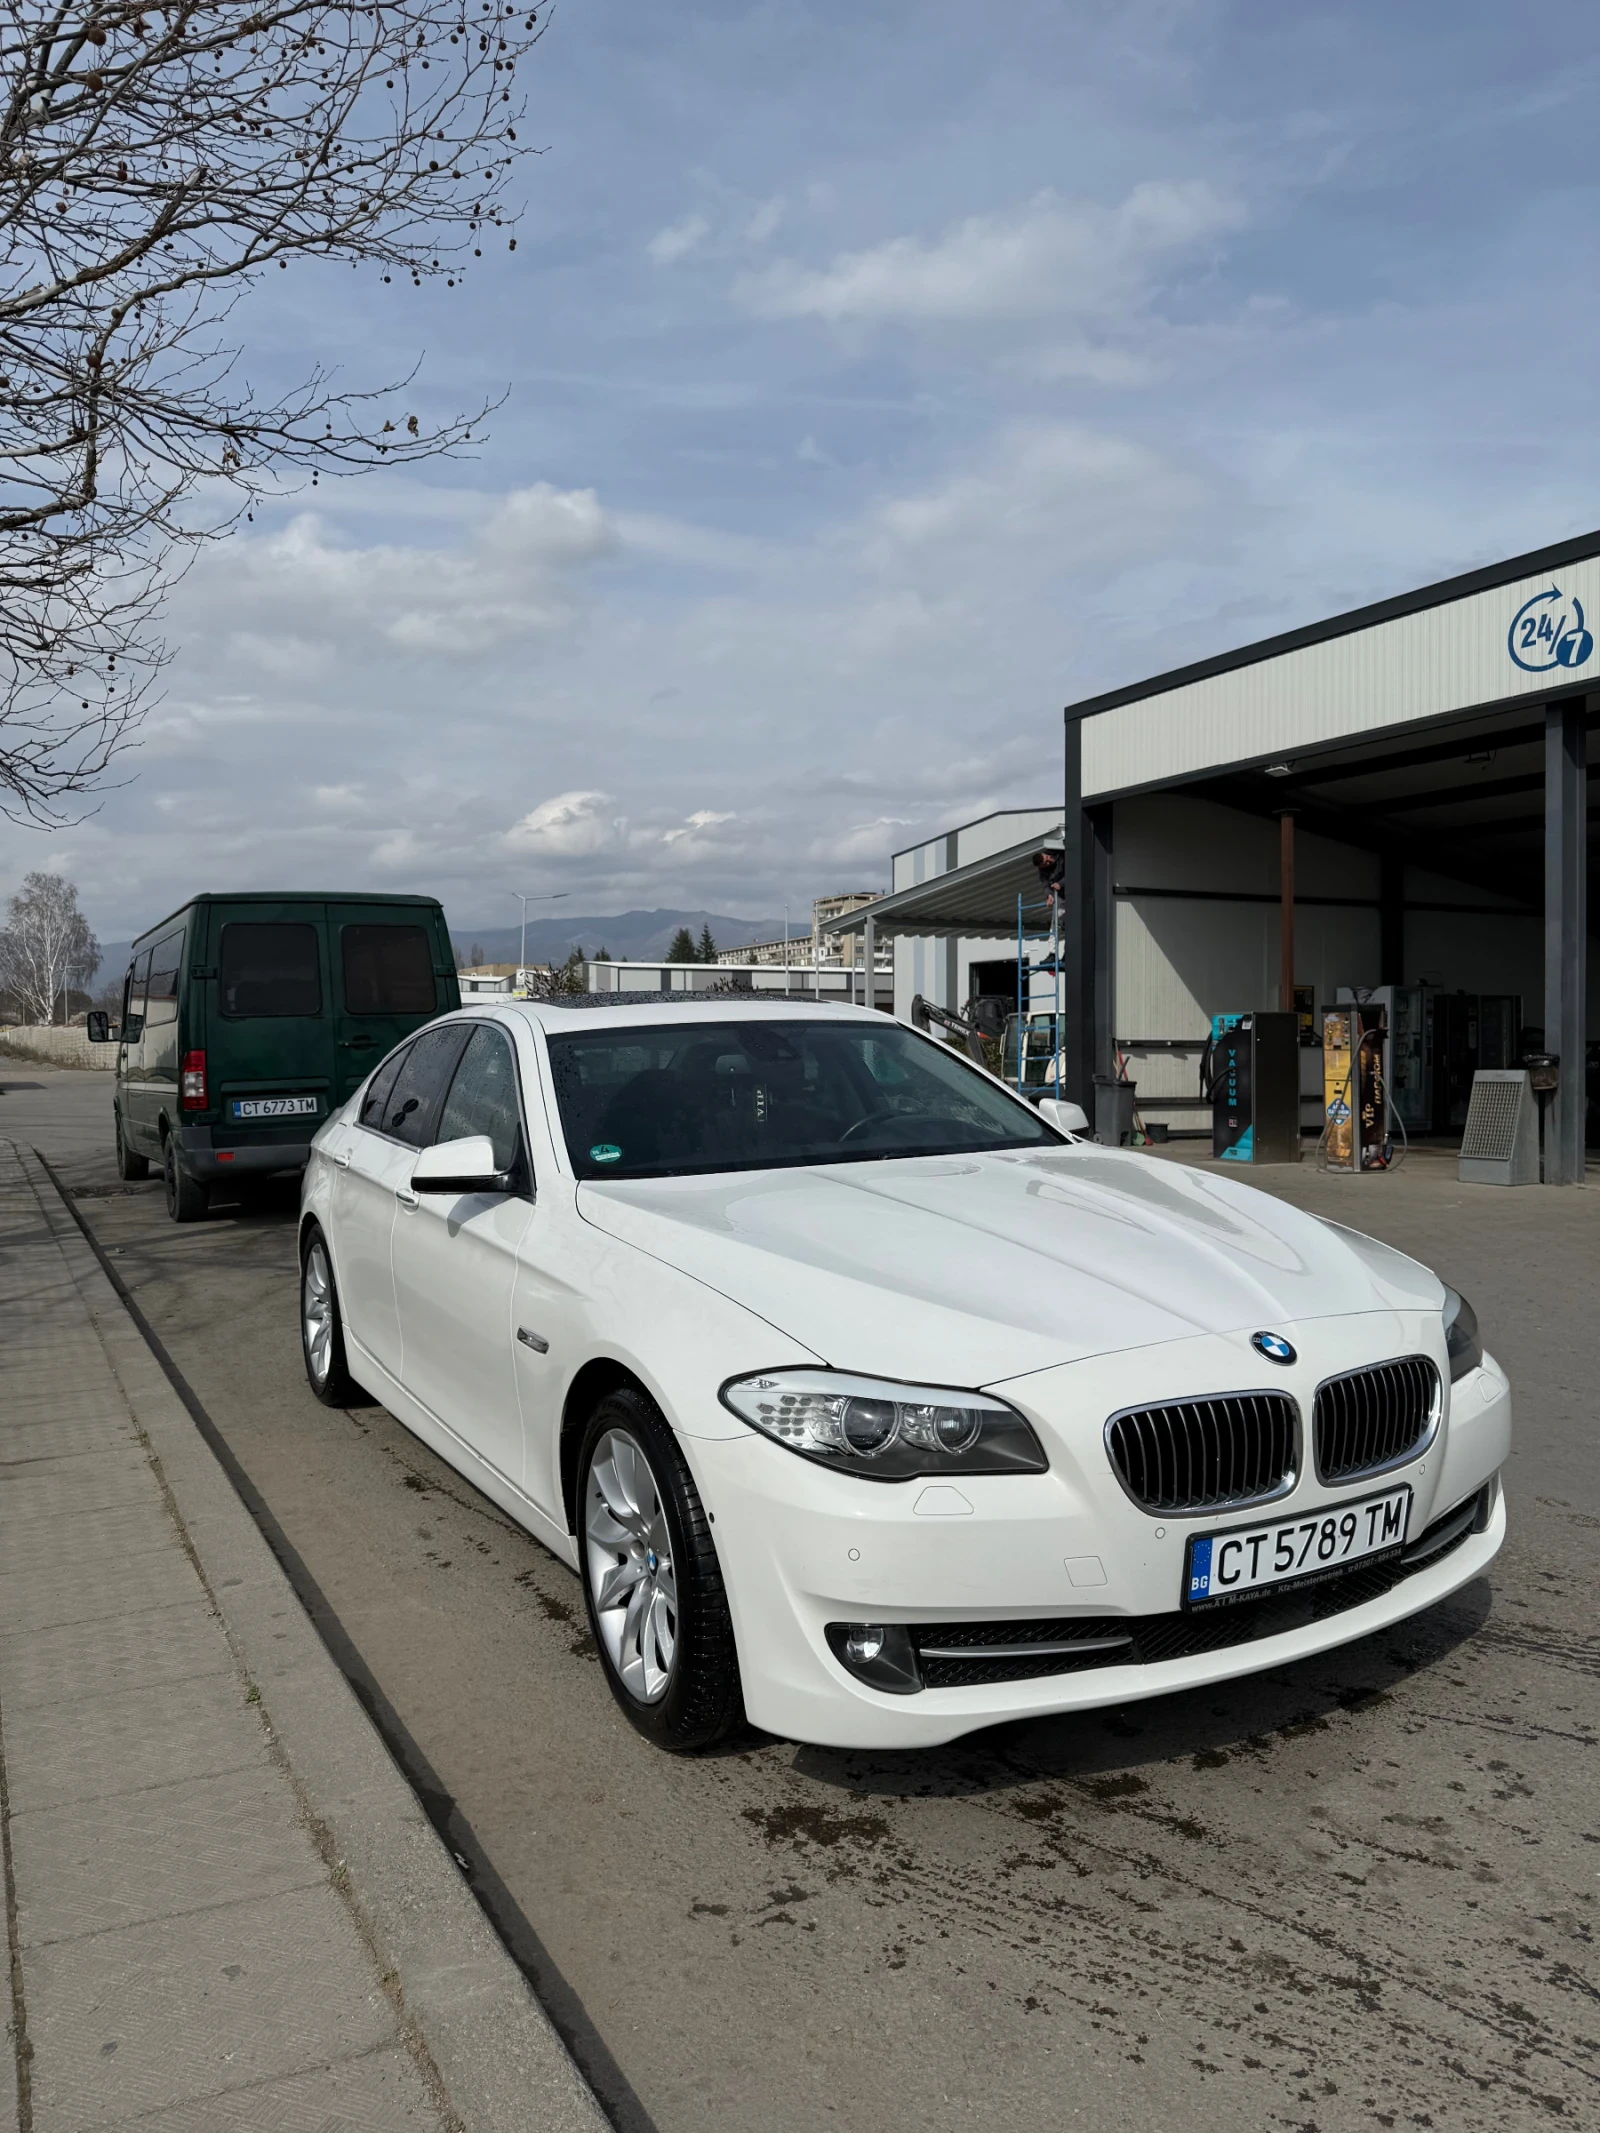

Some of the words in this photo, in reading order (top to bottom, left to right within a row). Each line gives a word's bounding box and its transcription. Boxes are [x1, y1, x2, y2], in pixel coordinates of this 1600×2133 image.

[1521, 613, 1583, 665] 24/7
[950, 1021, 971, 1036] TEREX
[243, 1102, 260, 1115] CT
[263, 1100, 295, 1114] 6773
[297, 1099, 315, 1112] TM
[1365, 1103, 1375, 1129] VIP
[1218, 1533, 1268, 1586] CT
[1274, 1513, 1357, 1572] 5789
[1365, 1496, 1403, 1546] TM
[1191, 1576, 1209, 1591] BG
